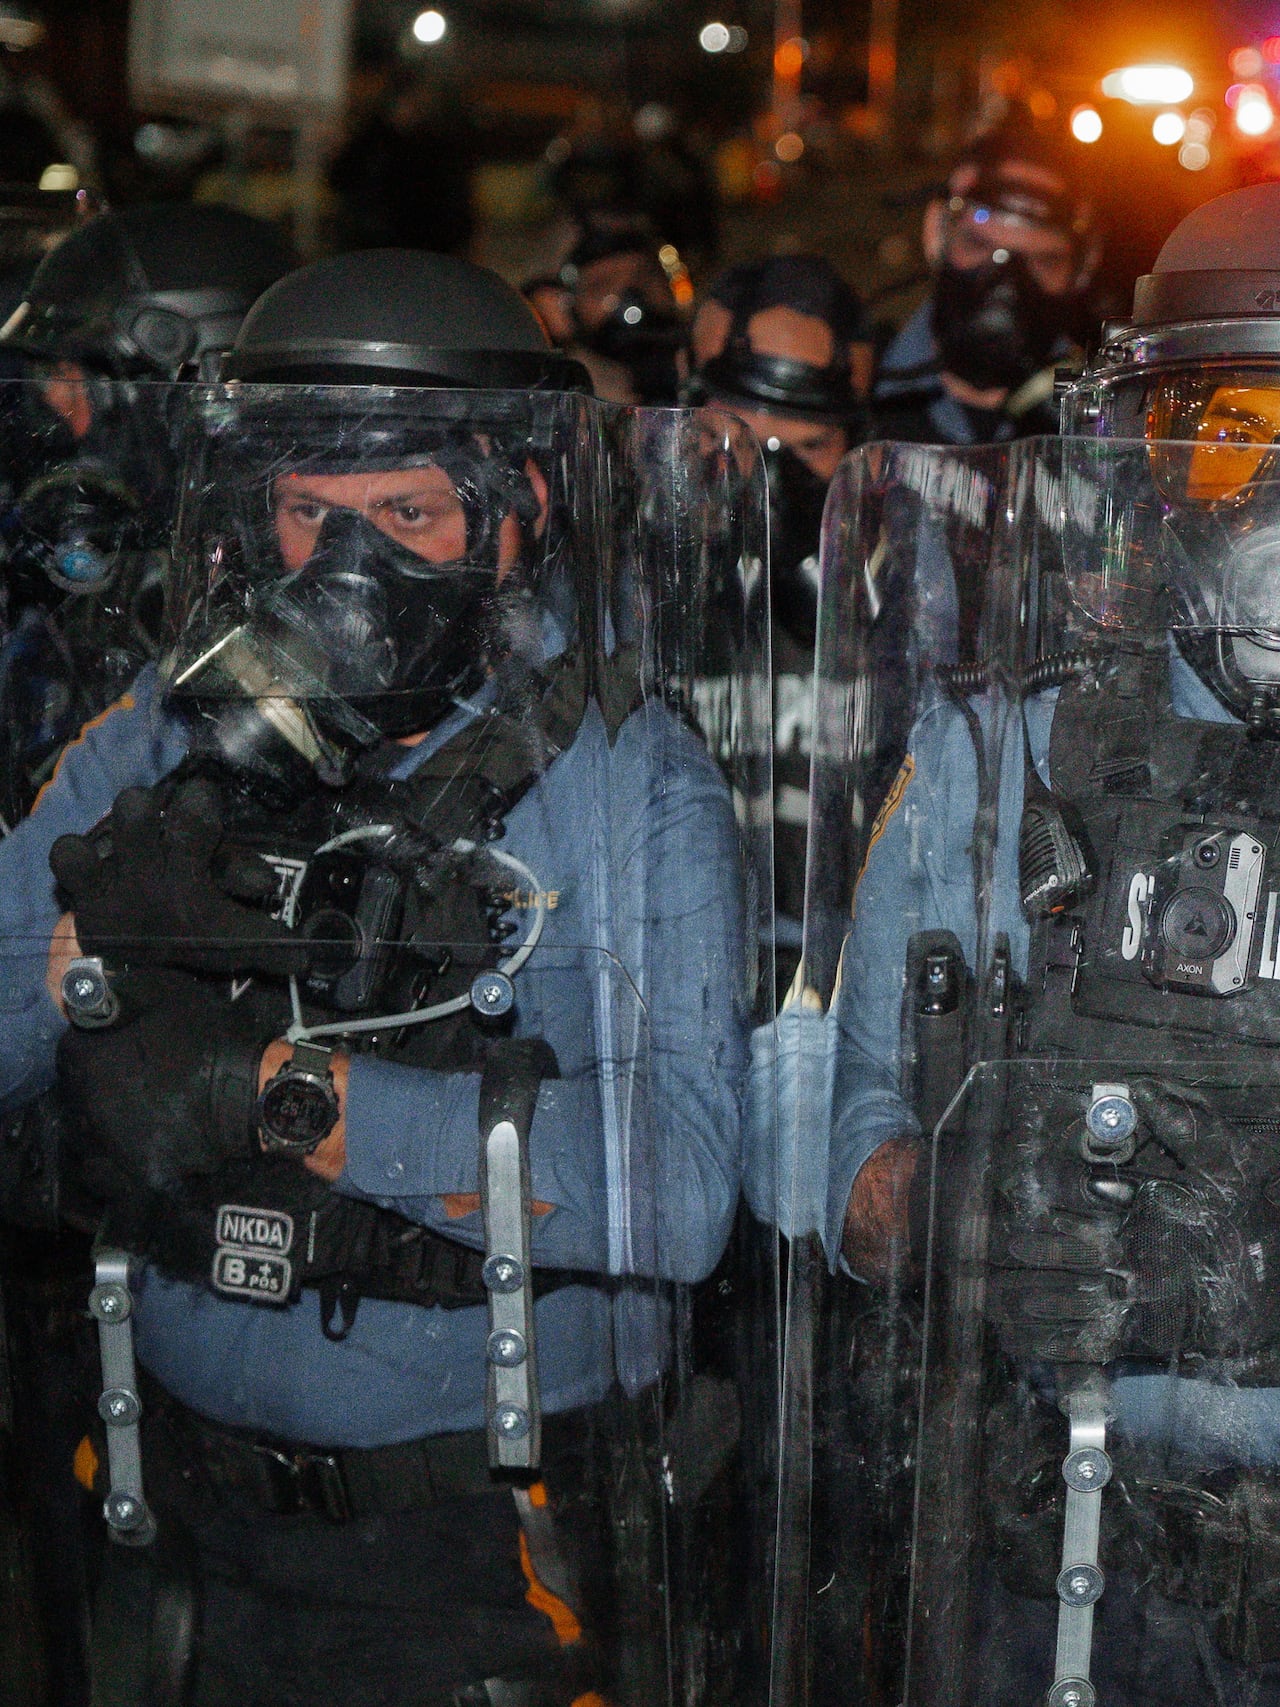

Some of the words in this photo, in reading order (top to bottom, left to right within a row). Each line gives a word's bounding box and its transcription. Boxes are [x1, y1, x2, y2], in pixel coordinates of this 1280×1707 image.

[1176, 963, 1203, 975] AXON
[223, 1213, 284, 1246] NKDA
[223, 1258, 246, 1285] B
[249, 1274, 279, 1292] POS
